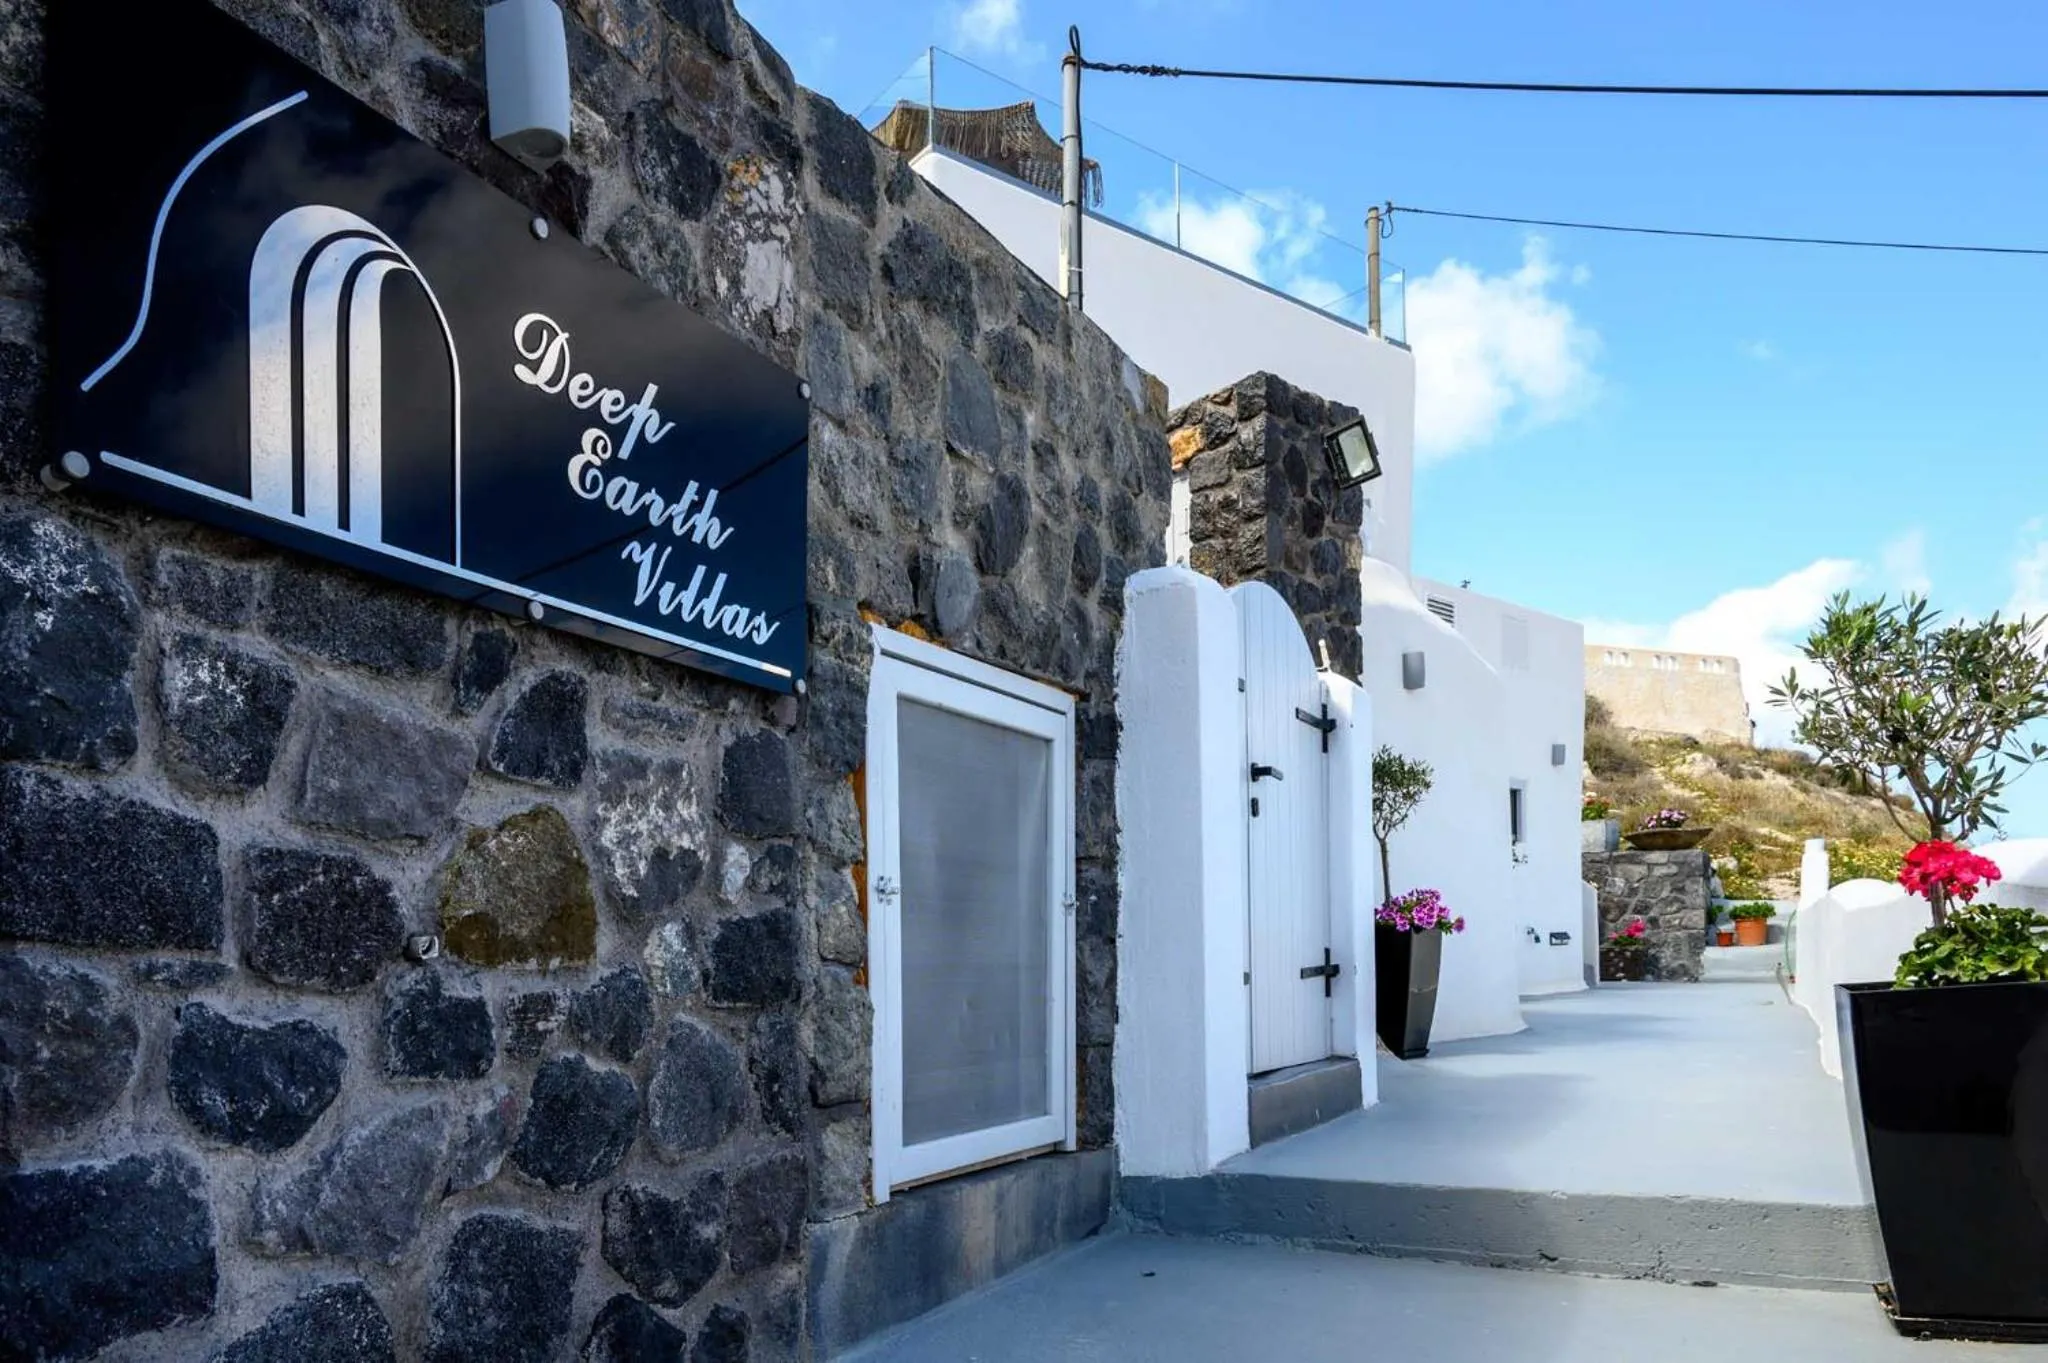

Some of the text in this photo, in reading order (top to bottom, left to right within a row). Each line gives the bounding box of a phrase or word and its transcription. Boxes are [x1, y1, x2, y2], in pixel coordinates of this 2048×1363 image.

[513, 312, 676, 460] Deep
[567, 427, 734, 550] Earth
[621, 541, 780, 645] Villas
